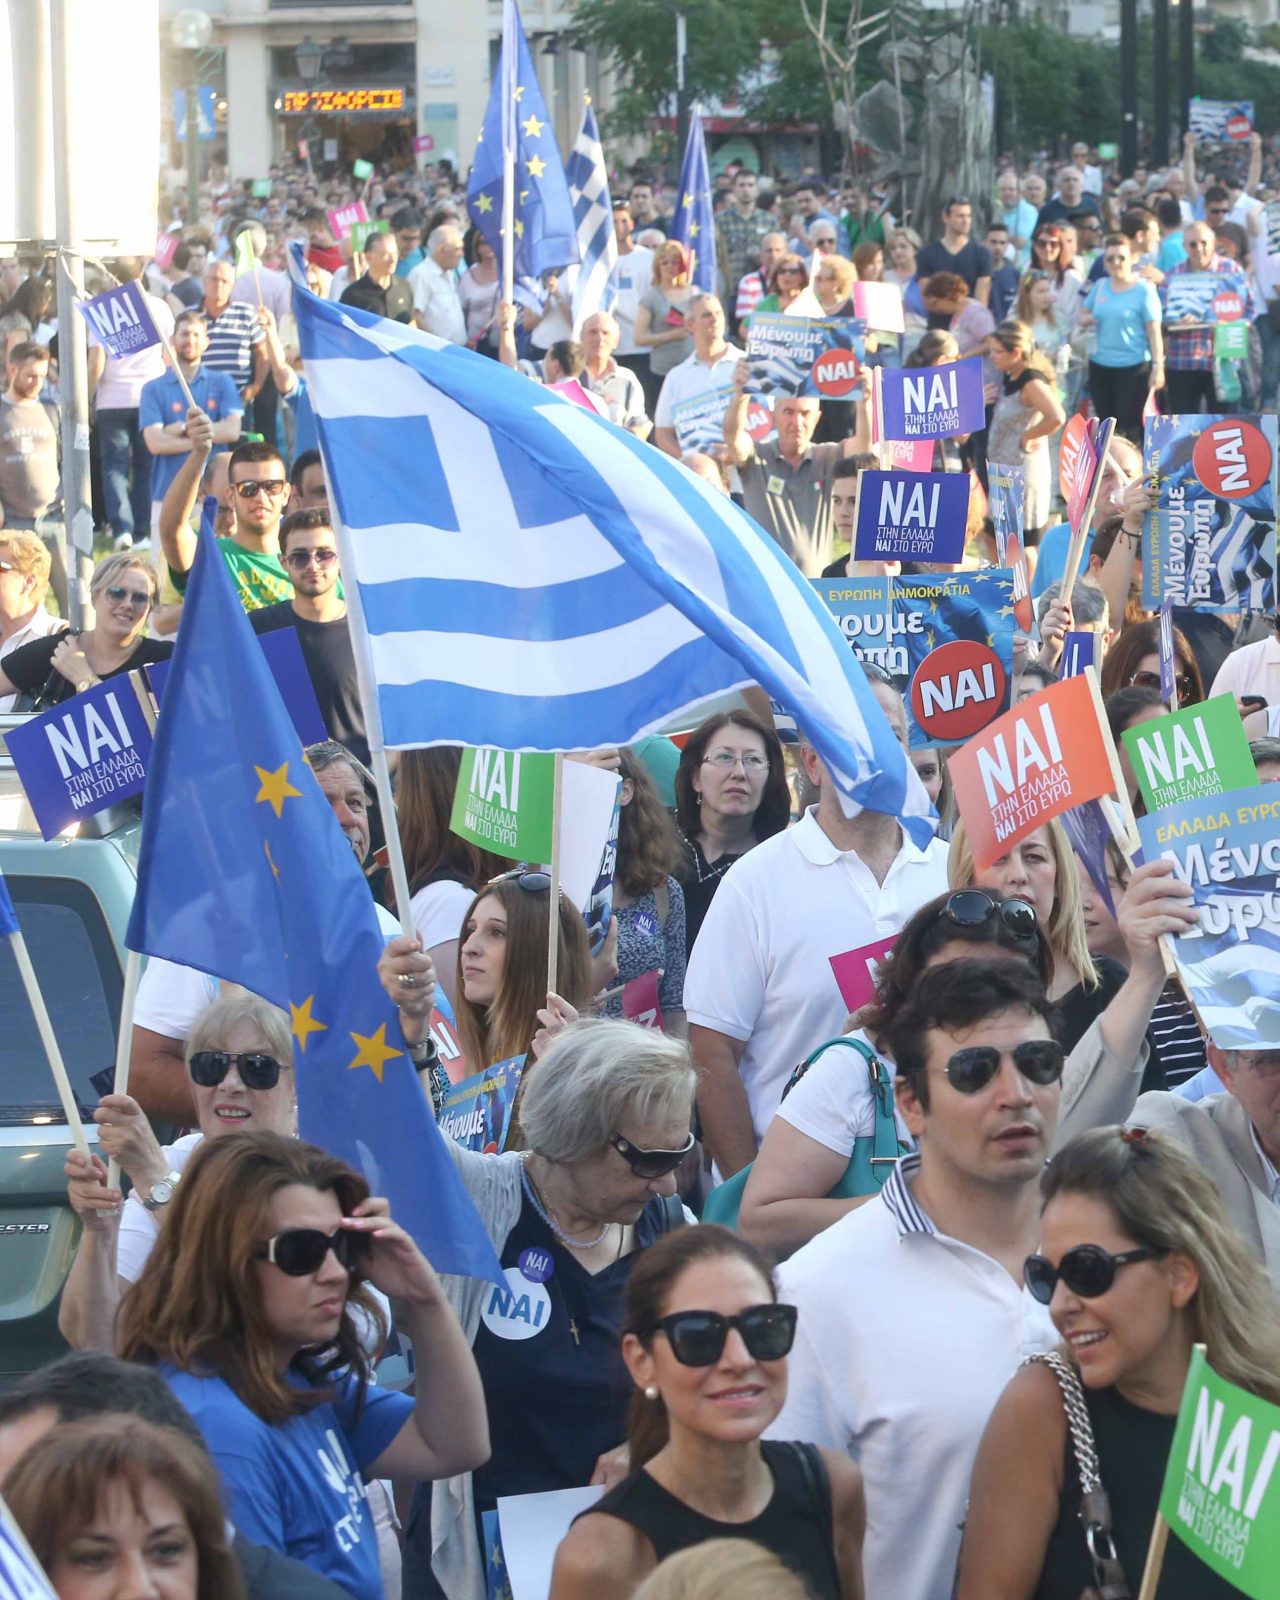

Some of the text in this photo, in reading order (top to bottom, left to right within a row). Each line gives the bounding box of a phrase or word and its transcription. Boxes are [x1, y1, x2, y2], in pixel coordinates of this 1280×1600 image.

[88, 291, 140, 338] ΝΑΙ
[816, 361, 856, 383] ΝΑΙ
[903, 370, 958, 413] ΝΑΙ
[905, 409, 959, 425] ΣΤΗΝ ΕΛΛΑΔΑ
[905, 419, 959, 435] ΝΑΙ ΣΤΟ ΕΥΡΩ
[1213, 427, 1250, 492] ΝΑΙ
[878, 481, 940, 528] ΝΑΙ
[875, 540, 933, 553] ΝΑΙ ΣΤΟ ΕΥΡΩ
[877, 526, 934, 541] ΣΤΗΝ ΕΛΛΑΔΑ
[1164, 487, 1191, 601] Μένουμε
[1188, 500, 1216, 599] Ευρώπη
[829, 584, 971, 602] ΕΥΡΩΠΗ ΔΗΜΟΚΡΑΤΙΑ
[838, 611, 924, 643] ουμε
[919, 662, 996, 718] ΝΑΙ
[44, 692, 134, 779] ΝΑΙ
[976, 703, 1063, 808] ΝΑΙ
[1136, 716, 1216, 791] ΝΑΙ
[65, 748, 140, 795] ΣΤΗΝ ΕΛΛΑΔΑ
[70, 762, 146, 810] ΝΑΙ ΣΤΟ ΕΥΡΩ
[470, 750, 521, 813] ΝΑΙ
[1152, 787, 1178, 806] ΣΤΗΝ
[1179, 770, 1222, 796] ΕΛΛΑΔΑ
[466, 794, 518, 831] ΣΤΗΝ ΕΛΛΑΔΑ
[991, 763, 1069, 826] ΣΤΗΝ ΕΛΛΑΔΑ
[994, 819, 1017, 843] ΝΑΙ
[1017, 802, 1038, 827] ΣΤΟ
[1039, 779, 1072, 810] ΕΥΡΩ
[464, 810, 517, 848] ΝΑΙ ΣΤΟ ΕΥΡΩ
[1156, 811, 1232, 844] ΕΛΛΑΔΑ
[639, 915, 652, 927] ΝΑΙ
[430, 1021, 461, 1060] ΑΙ
[526, 1252, 548, 1271] ΝΑΙ
[488, 1287, 544, 1327] ΝΑΙ
[1177, 1498, 1245, 1569] ΝΑΙ ΣΤΟ ΕΥΡΩ
[1206, 1495, 1250, 1546] ΕΛΛΑΔΑ
